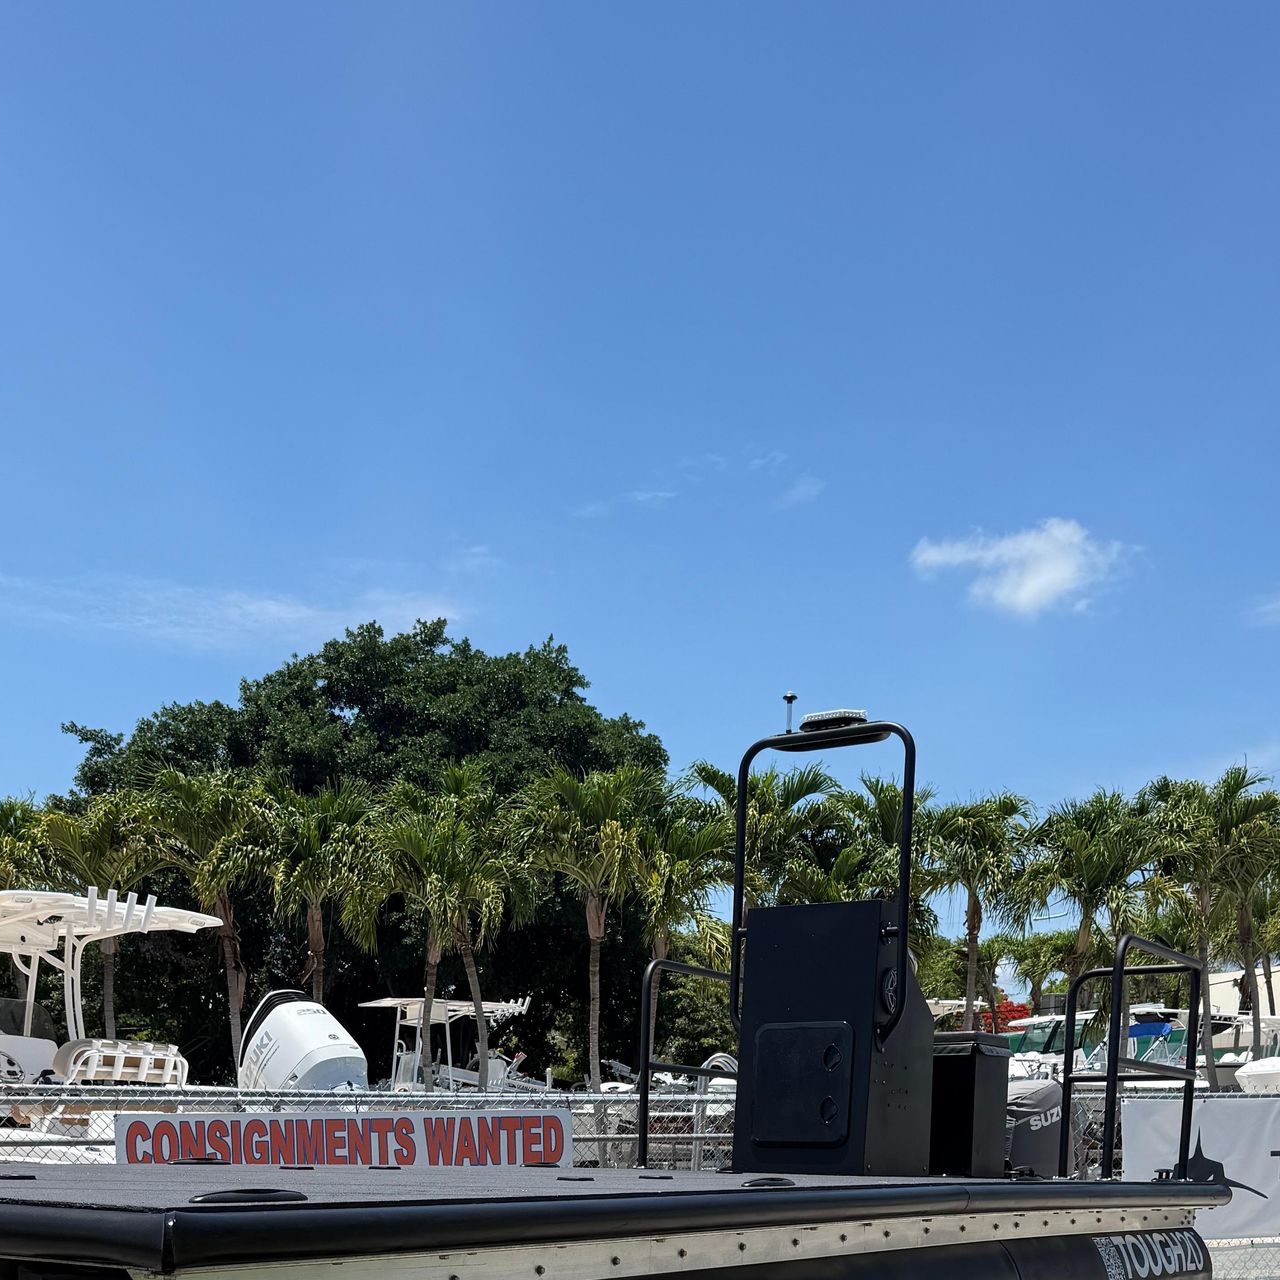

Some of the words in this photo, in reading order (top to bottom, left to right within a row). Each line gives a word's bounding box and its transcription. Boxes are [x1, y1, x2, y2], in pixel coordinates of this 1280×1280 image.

[243, 1030, 273, 1089] ZUKI
[125, 1116, 417, 1165] CONSIGNMENTS
[423, 1115, 565, 1166] WANTED
[1029, 1105, 1062, 1131] SUZ
